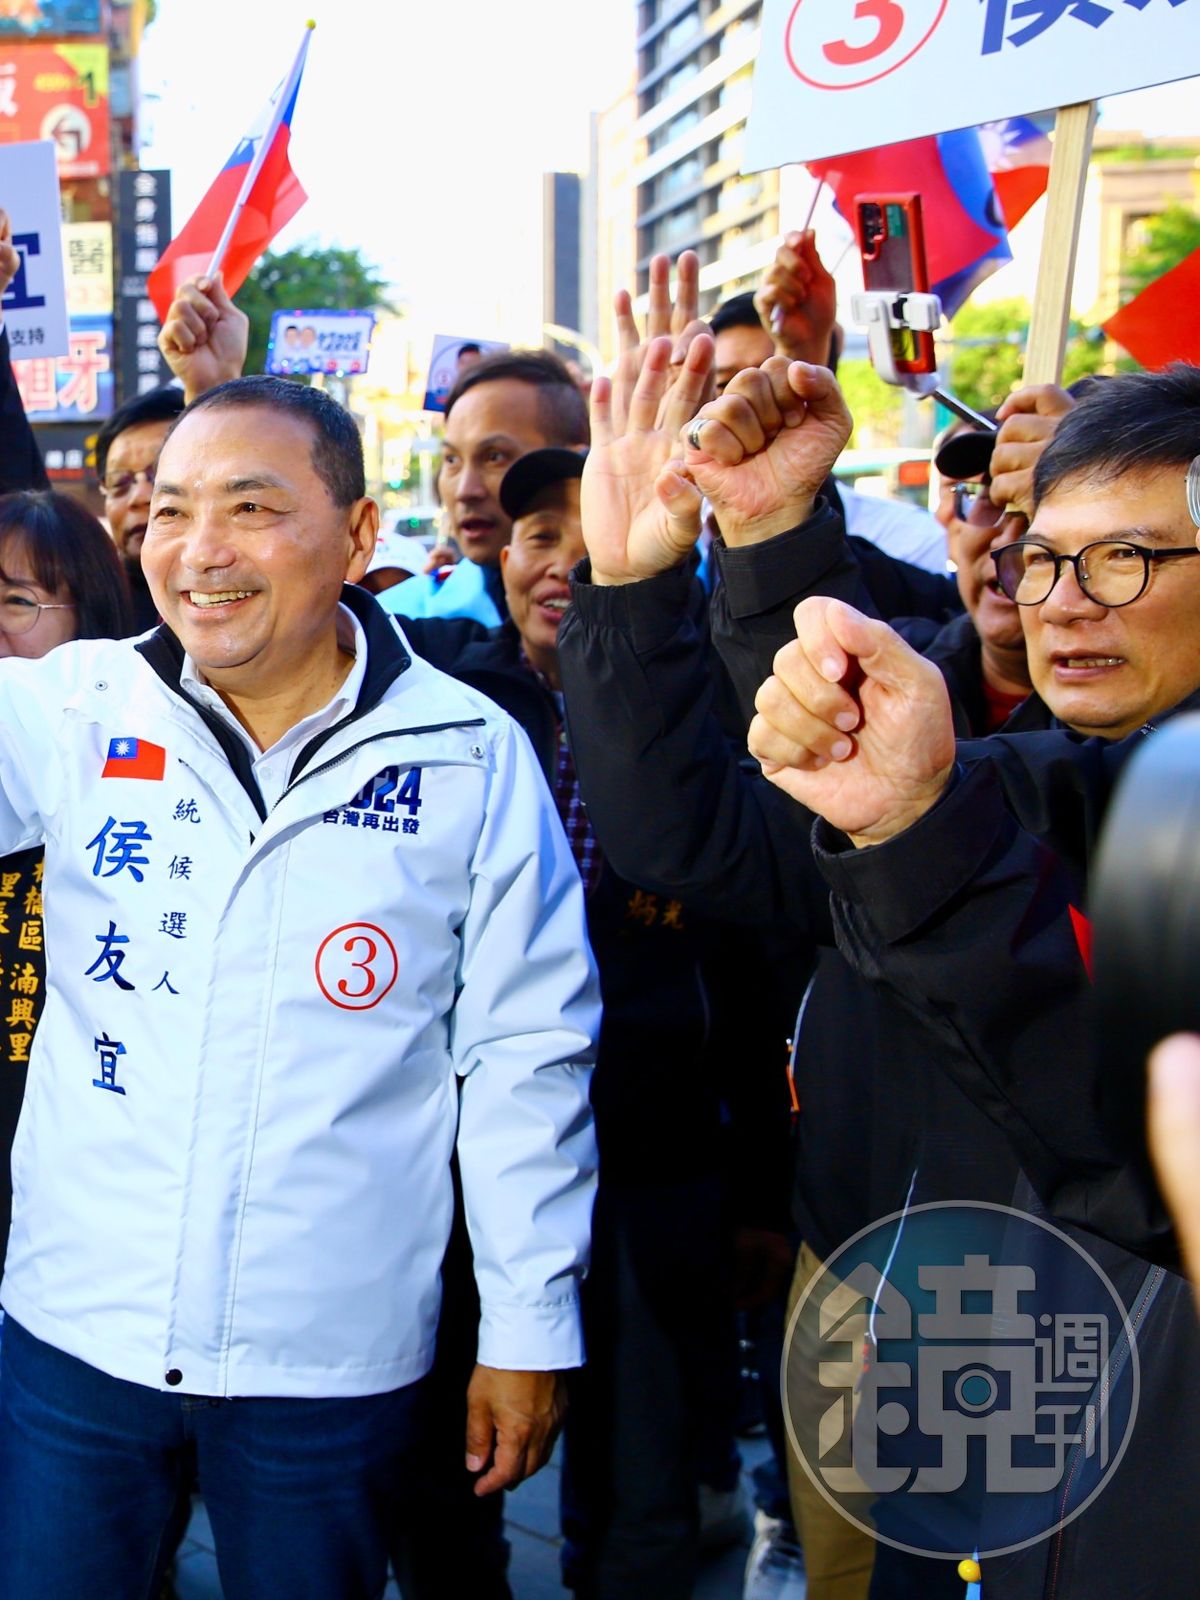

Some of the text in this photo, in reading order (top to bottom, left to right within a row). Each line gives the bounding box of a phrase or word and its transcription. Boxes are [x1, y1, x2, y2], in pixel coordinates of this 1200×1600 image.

[323, 808, 420, 835] 台灣再出發
[84, 815, 153, 1096] 侯友宜
[337, 935, 377, 998] 3
[6, 962, 39, 1062] 湳興里
